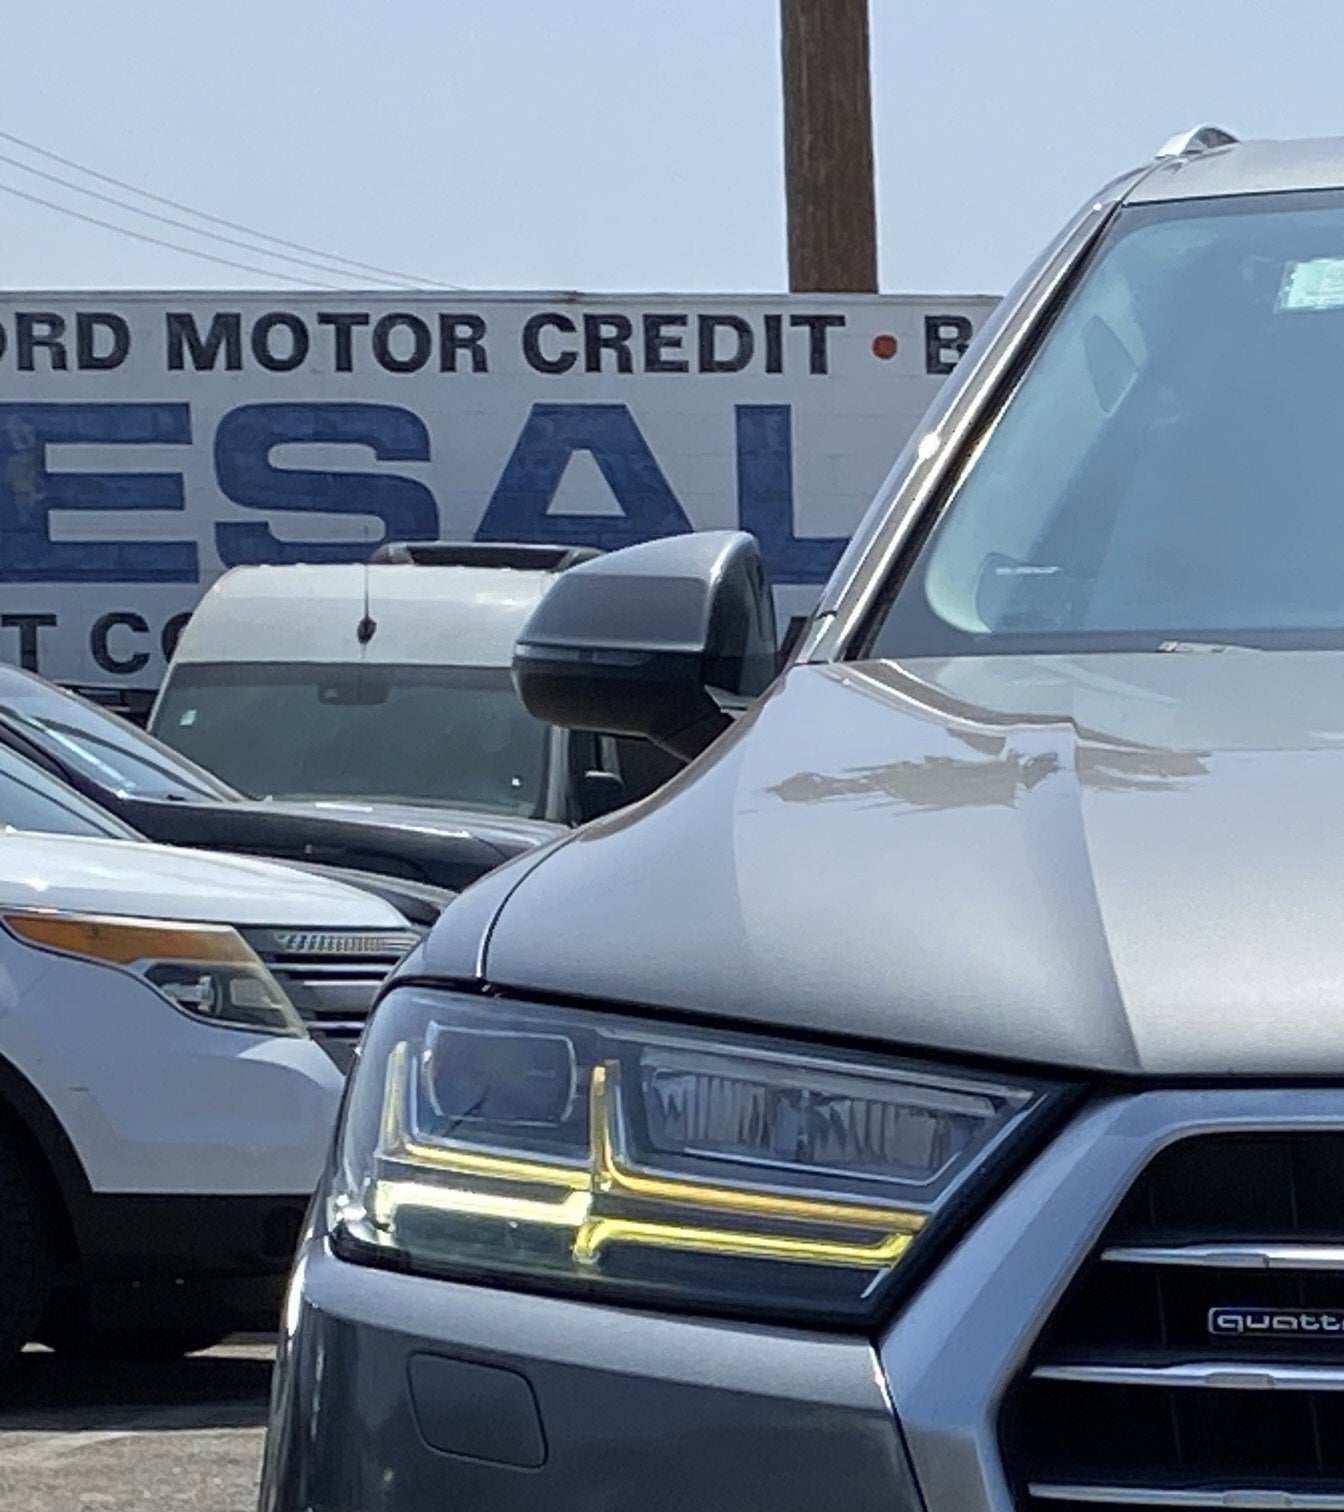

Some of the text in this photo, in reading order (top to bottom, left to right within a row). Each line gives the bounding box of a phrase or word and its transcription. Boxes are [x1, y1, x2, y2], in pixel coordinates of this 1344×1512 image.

[0, 311, 131, 371] RD
[166, 312, 489, 373] MOTOR
[521, 313, 847, 375] CREDIT
